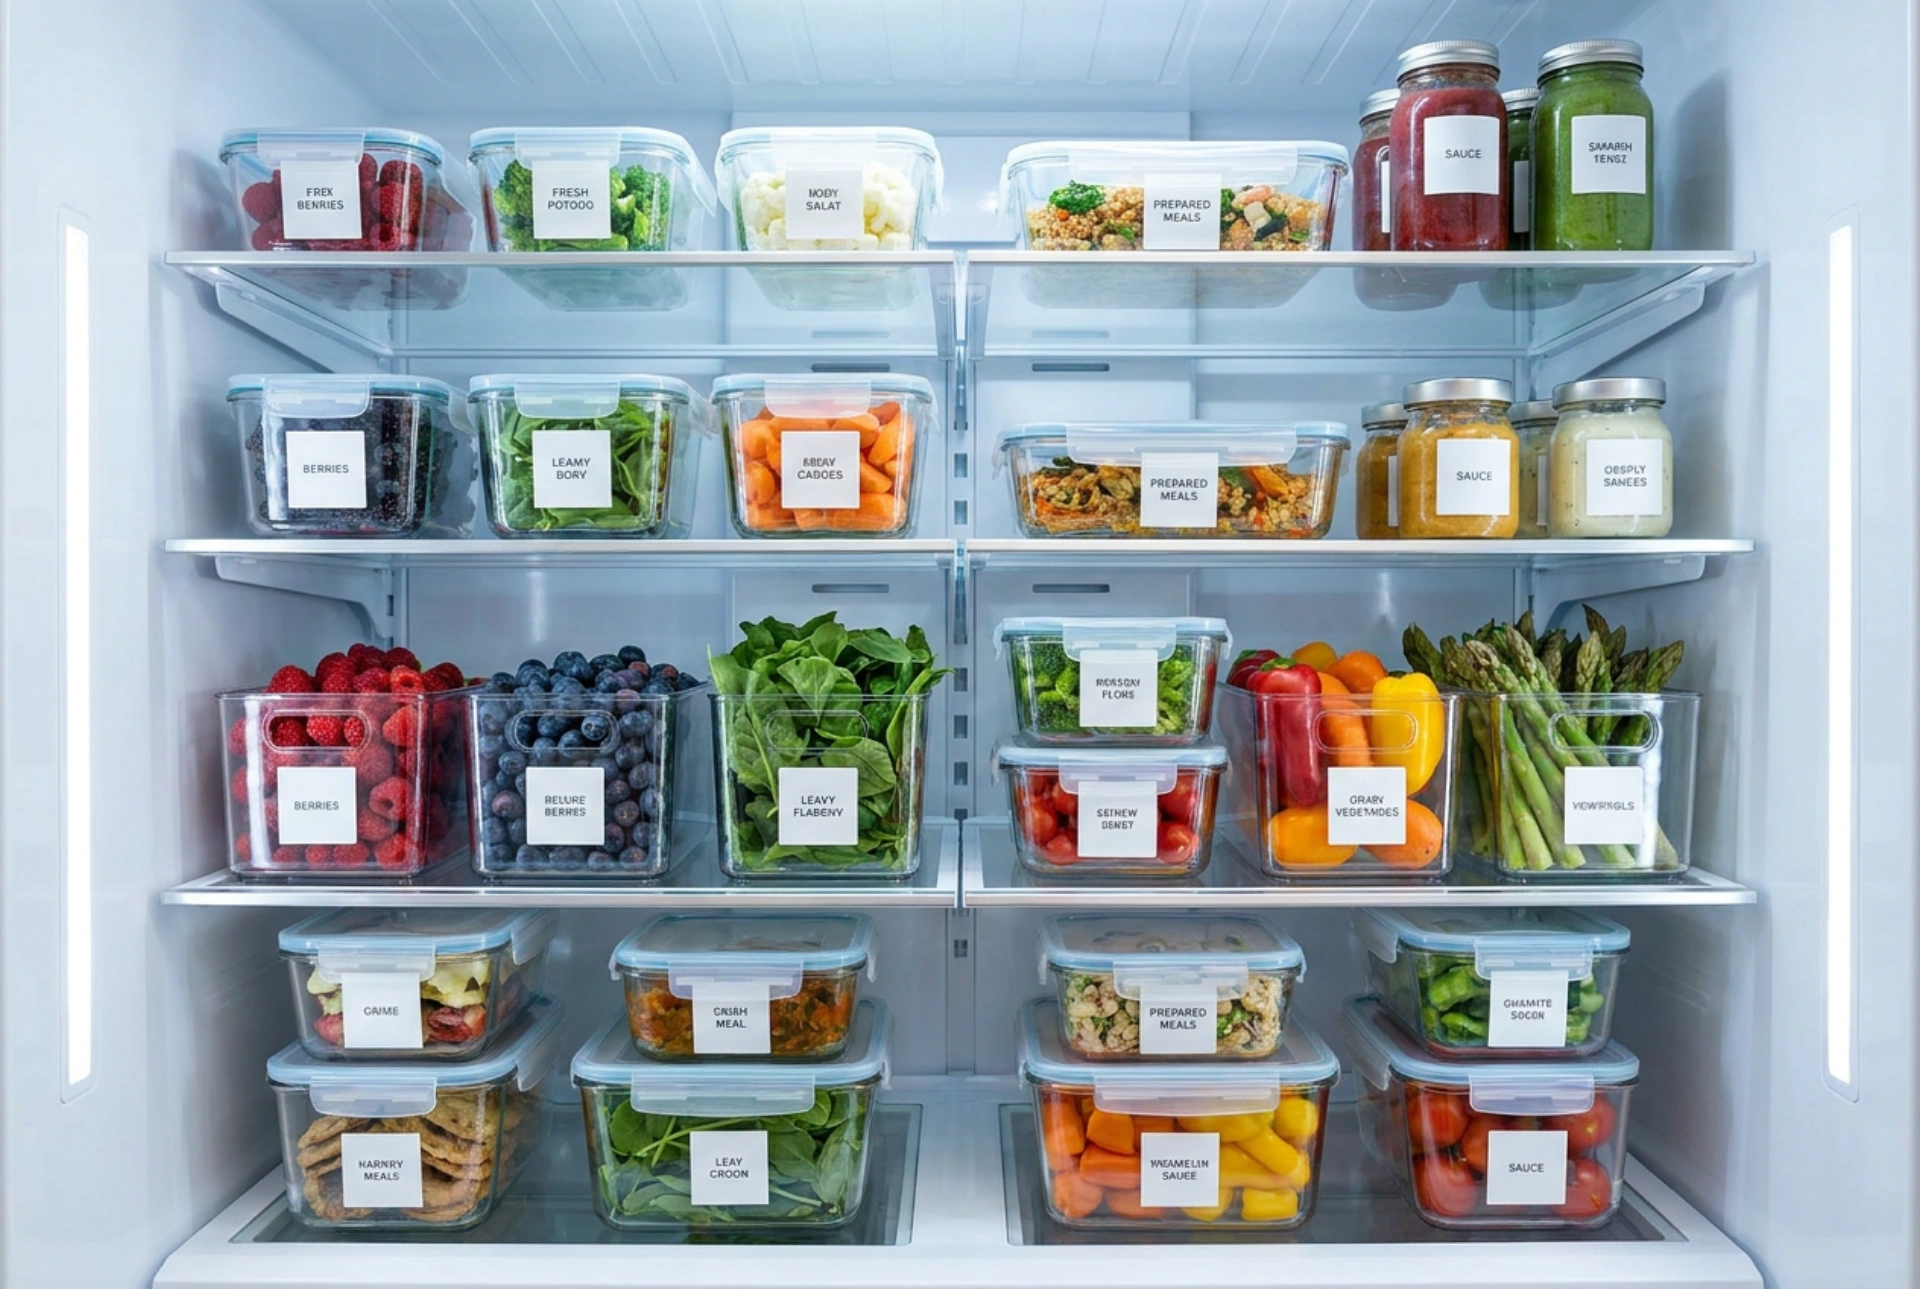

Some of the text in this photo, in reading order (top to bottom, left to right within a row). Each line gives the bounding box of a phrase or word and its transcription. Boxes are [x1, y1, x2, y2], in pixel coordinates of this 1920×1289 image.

[1445, 148, 1482, 159] SAUCE
[552, 187, 589, 198] FRESH
[805, 200, 842, 212] SALAT
[1153, 199, 1212, 210] PREPARED
[1163, 212, 1201, 223] MEALS
[552, 456, 591, 468] LEAMY
[302, 464, 350, 474] BERRIES
[556, 469, 588, 480] BORY
[1456, 470, 1493, 482] SAUCE
[1150, 478, 1209, 489] PREPARED
[1160, 490, 1199, 501] MEALS
[801, 794, 836, 805] LEAVY
[293, 800, 340, 811] BERRIES
[1149, 1007, 1207, 1018] PREPARED
[715, 1019, 747, 1029] MEAL
[1159, 1019, 1197, 1030] MEALS
[715, 1156, 743, 1167] LEAY
[1508, 1162, 1545, 1173] SAUCE
[363, 1171, 400, 1181] MEALS
[709, 1169, 750, 1179] CROON
